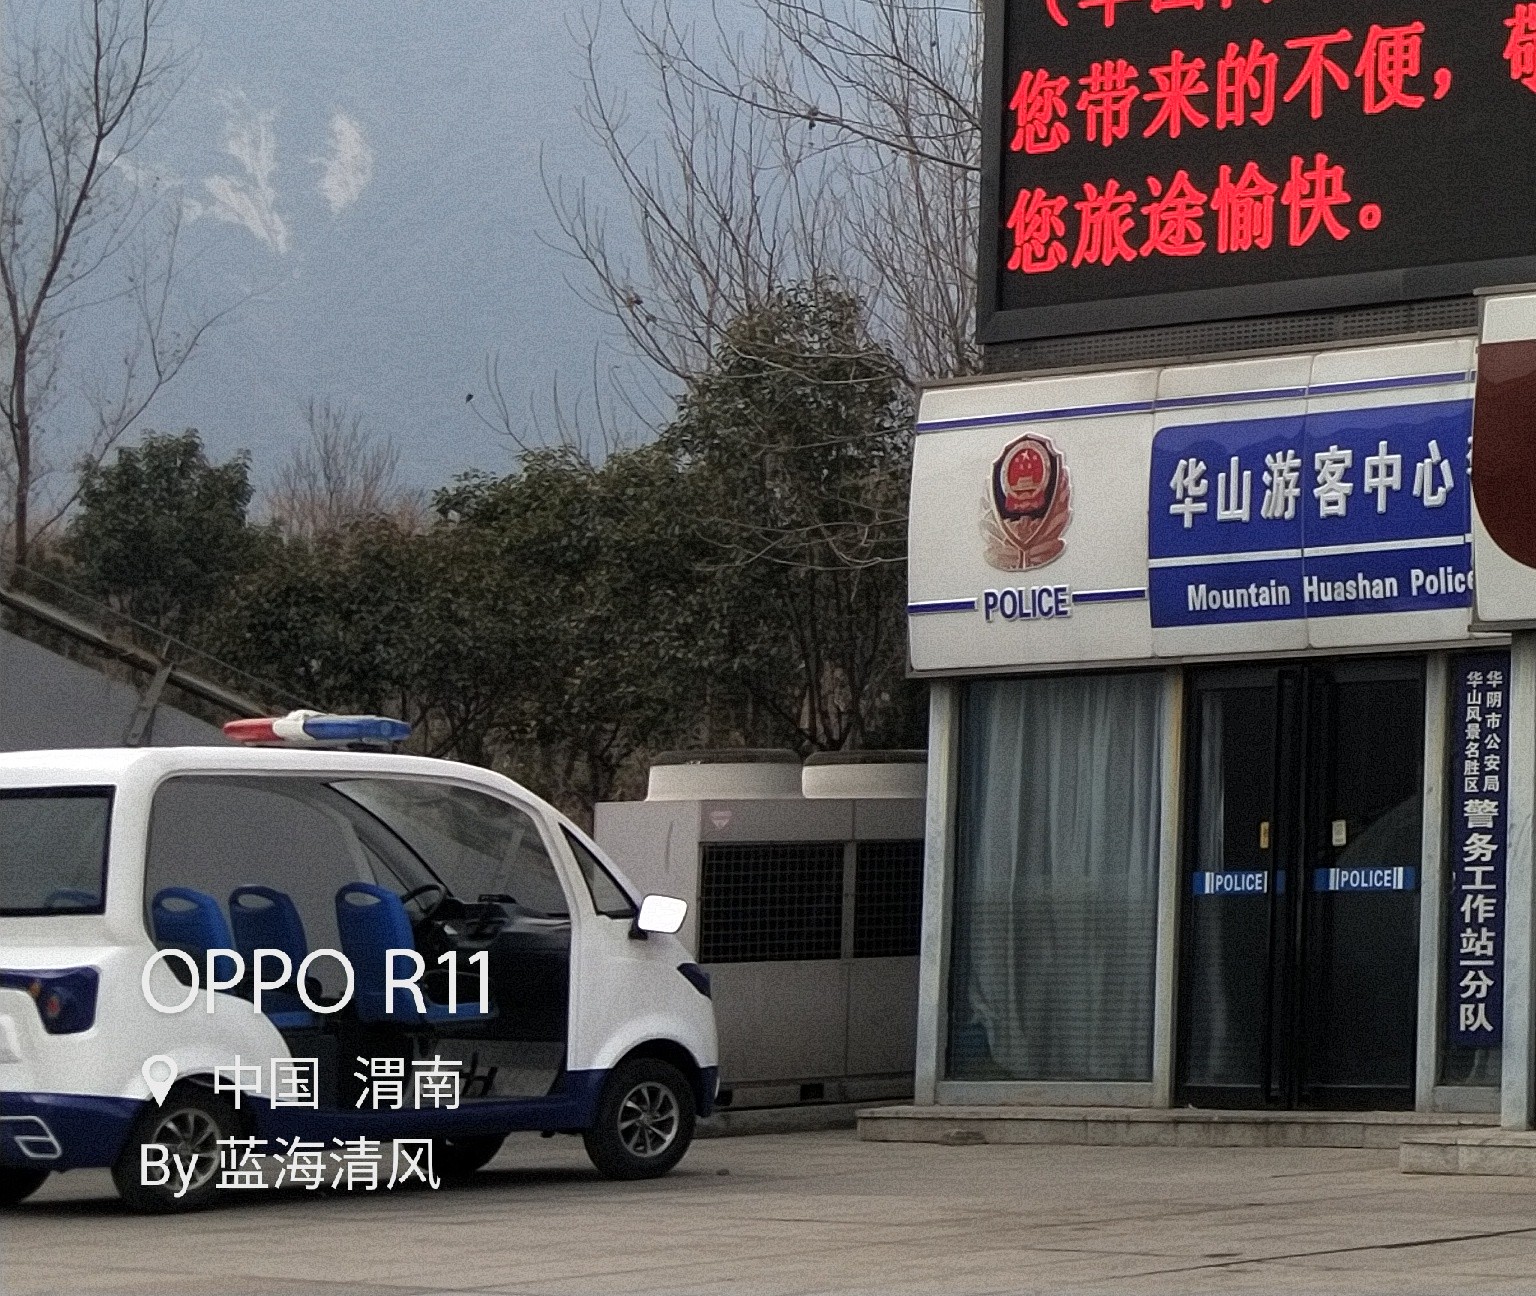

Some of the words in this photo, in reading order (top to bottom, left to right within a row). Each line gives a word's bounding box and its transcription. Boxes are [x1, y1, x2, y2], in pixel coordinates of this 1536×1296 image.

[1006, 152, 1381, 273] 您旅途愉快。
[1169, 436, 1474, 529] 华山游客中心
[984, 585, 1073, 621] POLICE
[1187, 579, 1291, 611] Mountain
[1303, 571, 1399, 603] Huashan
[1464, 671, 1483, 793] 华山风景名胜区
[1483, 670, 1503, 792] 华阴市公安局
[1214, 873, 1263, 891] POLICE
[1340, 869, 1392, 888] POLICE
[1459, 799, 1499, 1032] 警务工作站一分队
